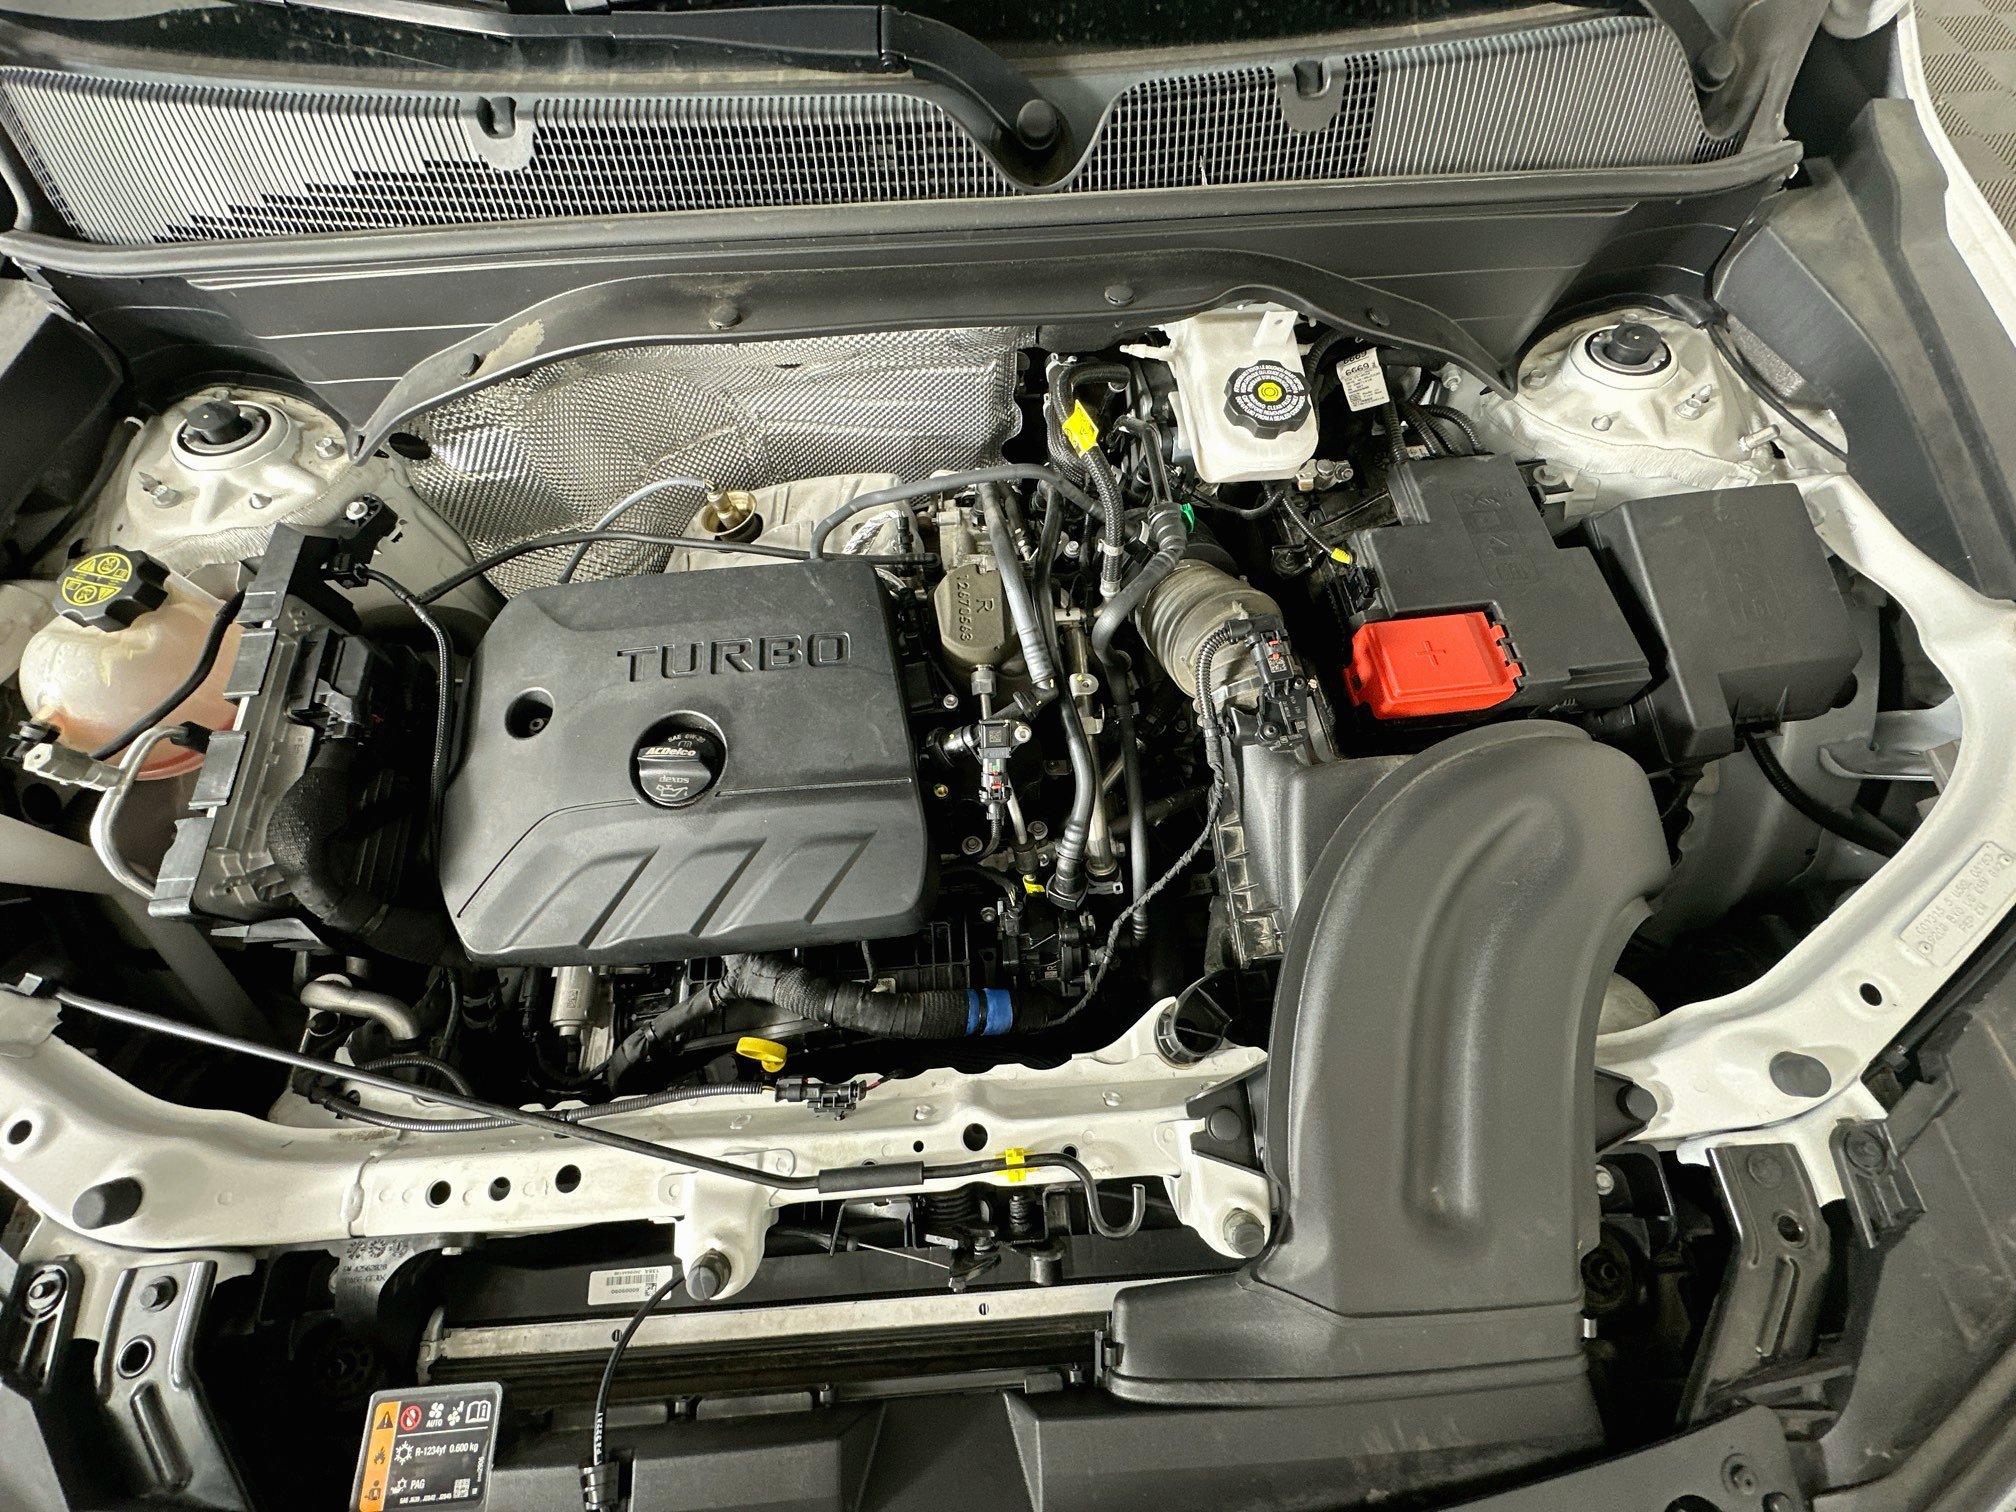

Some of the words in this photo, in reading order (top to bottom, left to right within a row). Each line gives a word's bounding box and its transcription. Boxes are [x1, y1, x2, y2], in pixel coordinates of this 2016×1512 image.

[1345, 362, 1370, 377] 6669
[976, 598, 995, 613] R
[616, 631, 851, 682] TURBO
[668, 734, 682, 743] SAE
[645, 747, 697, 756] ACDelco
[659, 775, 690, 783] dexos
[426, 1419, 443, 1427] AUTO
[415, 1444, 447, 1457] R-1234yf
[449, 1443, 469, 1453] 0.600
[469, 1442, 479, 1453] kg
[410, 1479, 426, 1490] PAG
